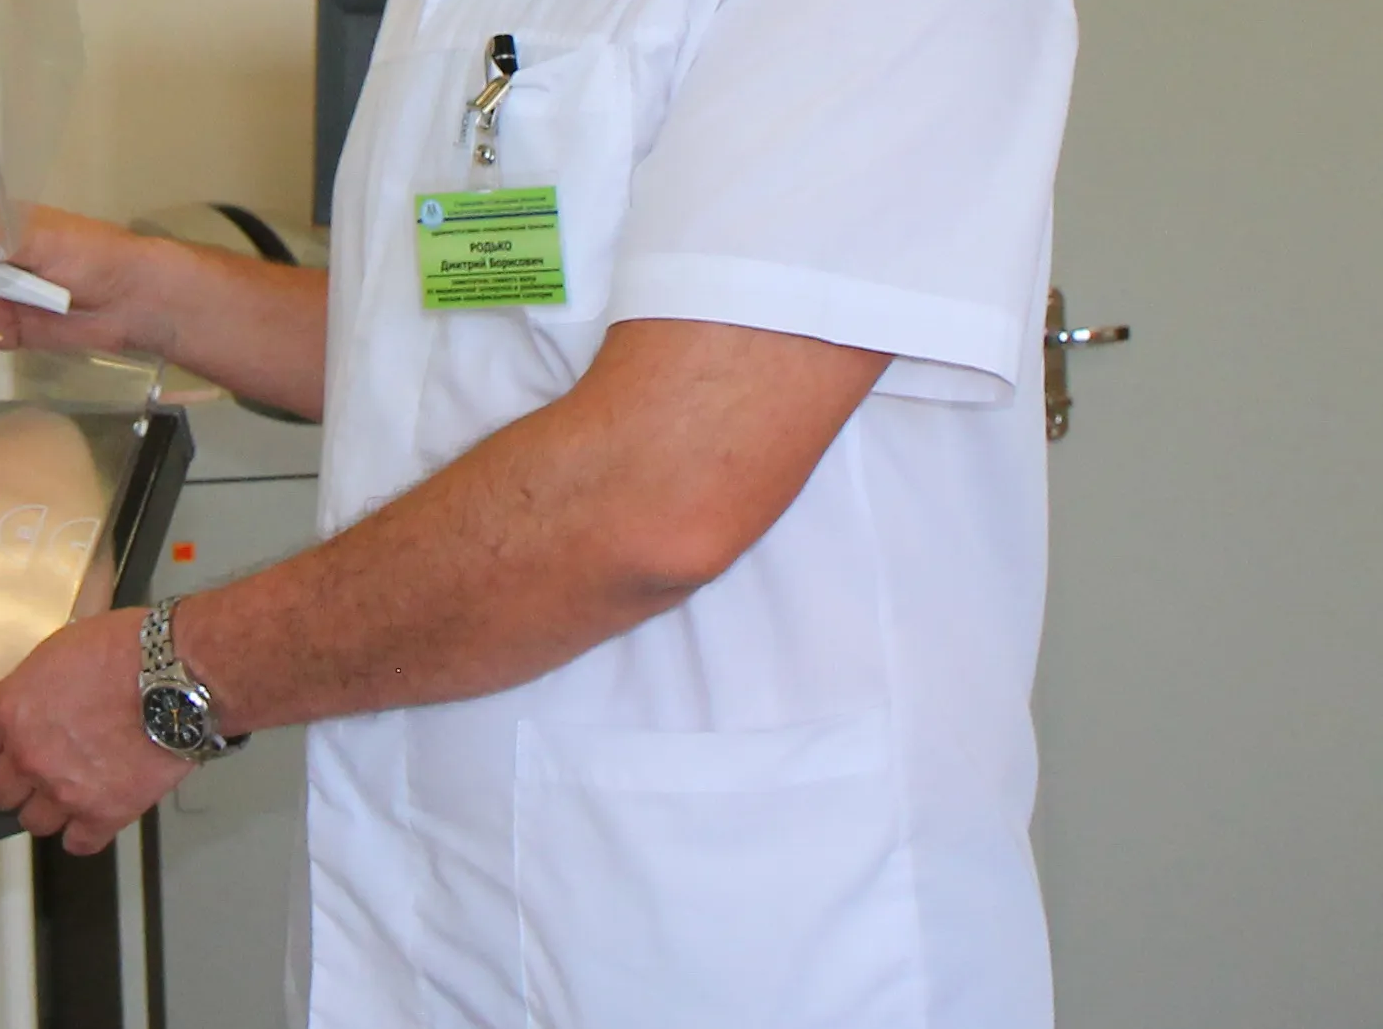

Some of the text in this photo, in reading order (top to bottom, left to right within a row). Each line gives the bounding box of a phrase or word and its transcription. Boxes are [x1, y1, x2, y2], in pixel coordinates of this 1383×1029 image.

[470, 240, 512, 253] РОДЬКО
[440, 257, 544, 272] Дмитрий Борисович
